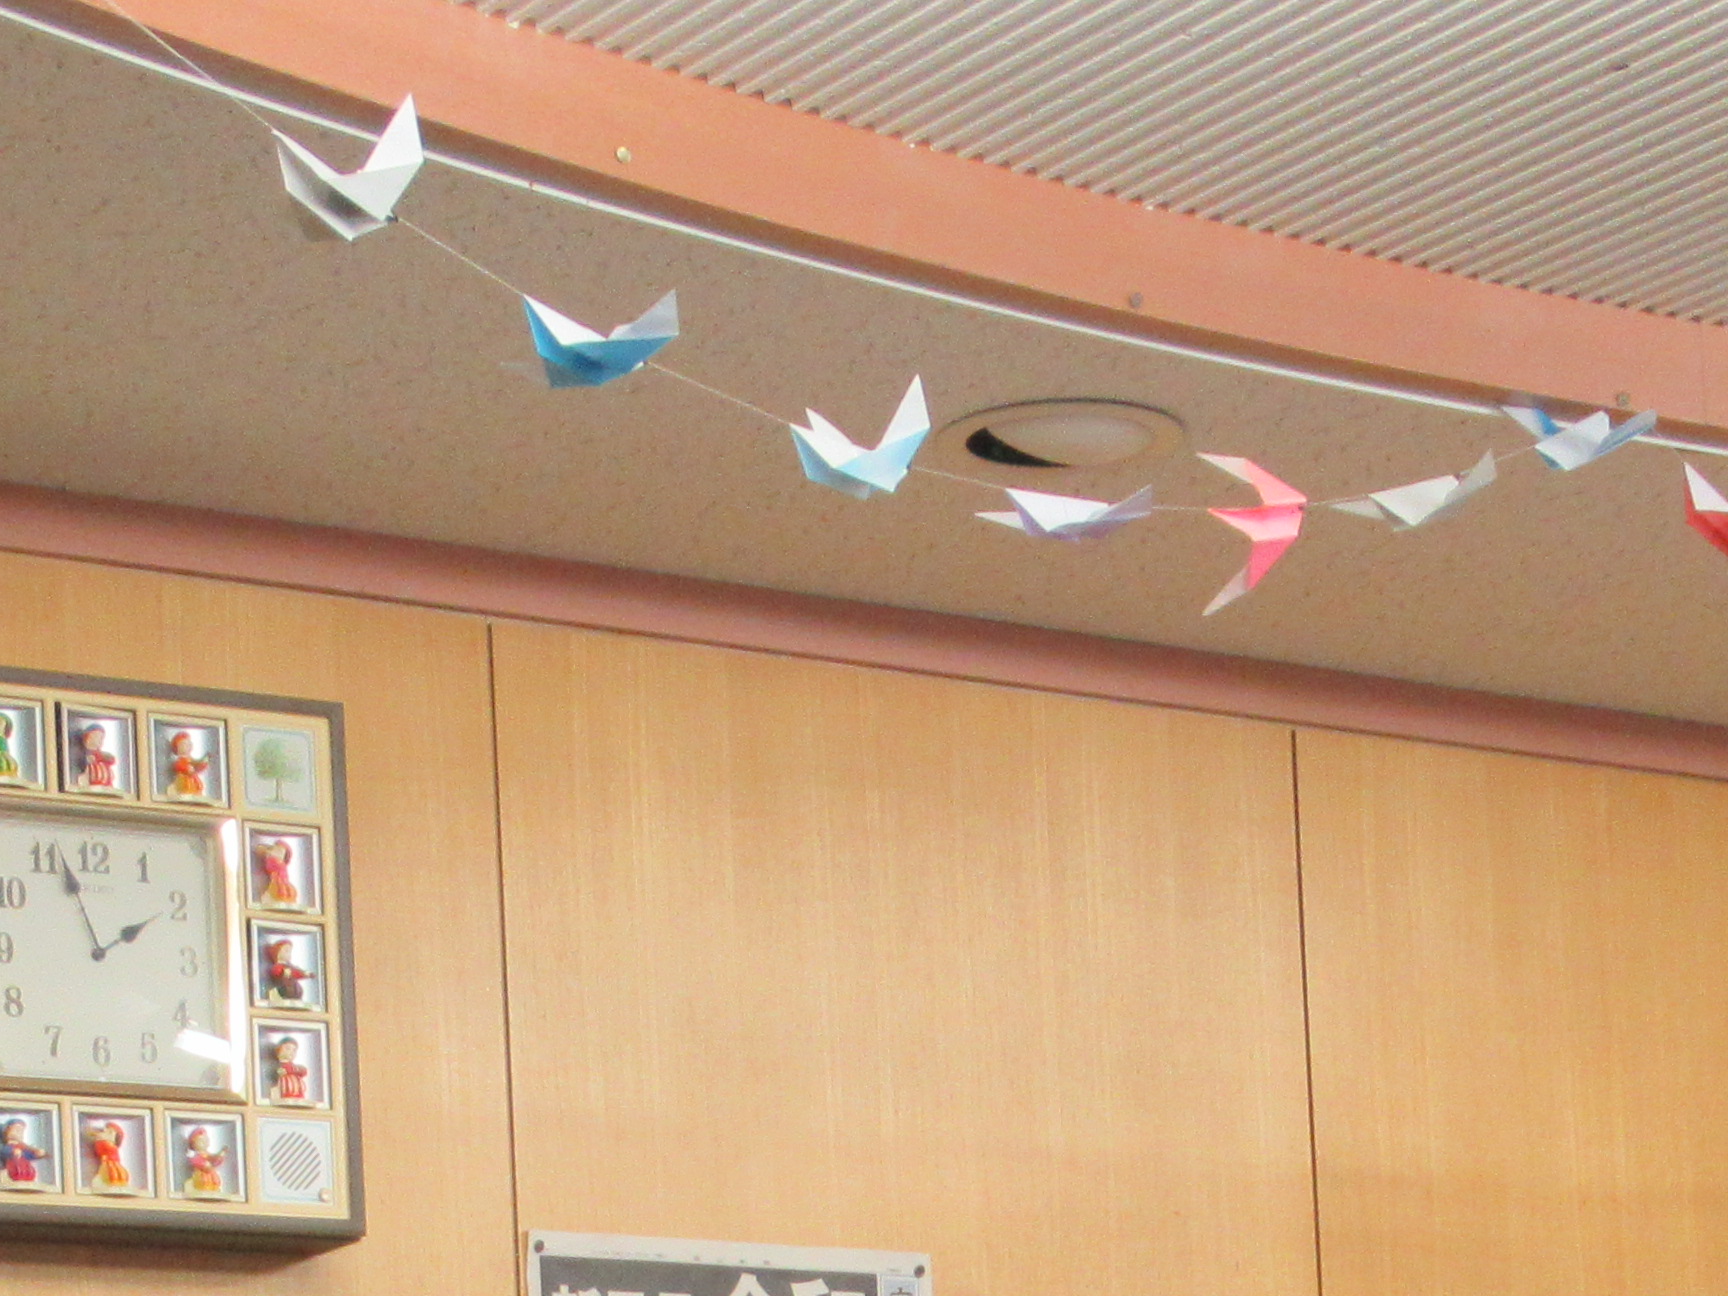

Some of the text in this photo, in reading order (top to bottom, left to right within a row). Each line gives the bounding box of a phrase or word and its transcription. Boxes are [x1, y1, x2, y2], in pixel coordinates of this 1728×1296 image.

[30, 841, 110, 874] 11 12
[137, 852, 151, 883] 1
[169, 890, 187, 921] 2
[180, 946, 198, 977] 3
[4, 986, 24, 1017] 8
[174, 999, 192, 1029] 4
[44, 1025, 63, 1057] 7
[92, 1036, 111, 1067] 6
[141, 1032, 158, 1063] 5
